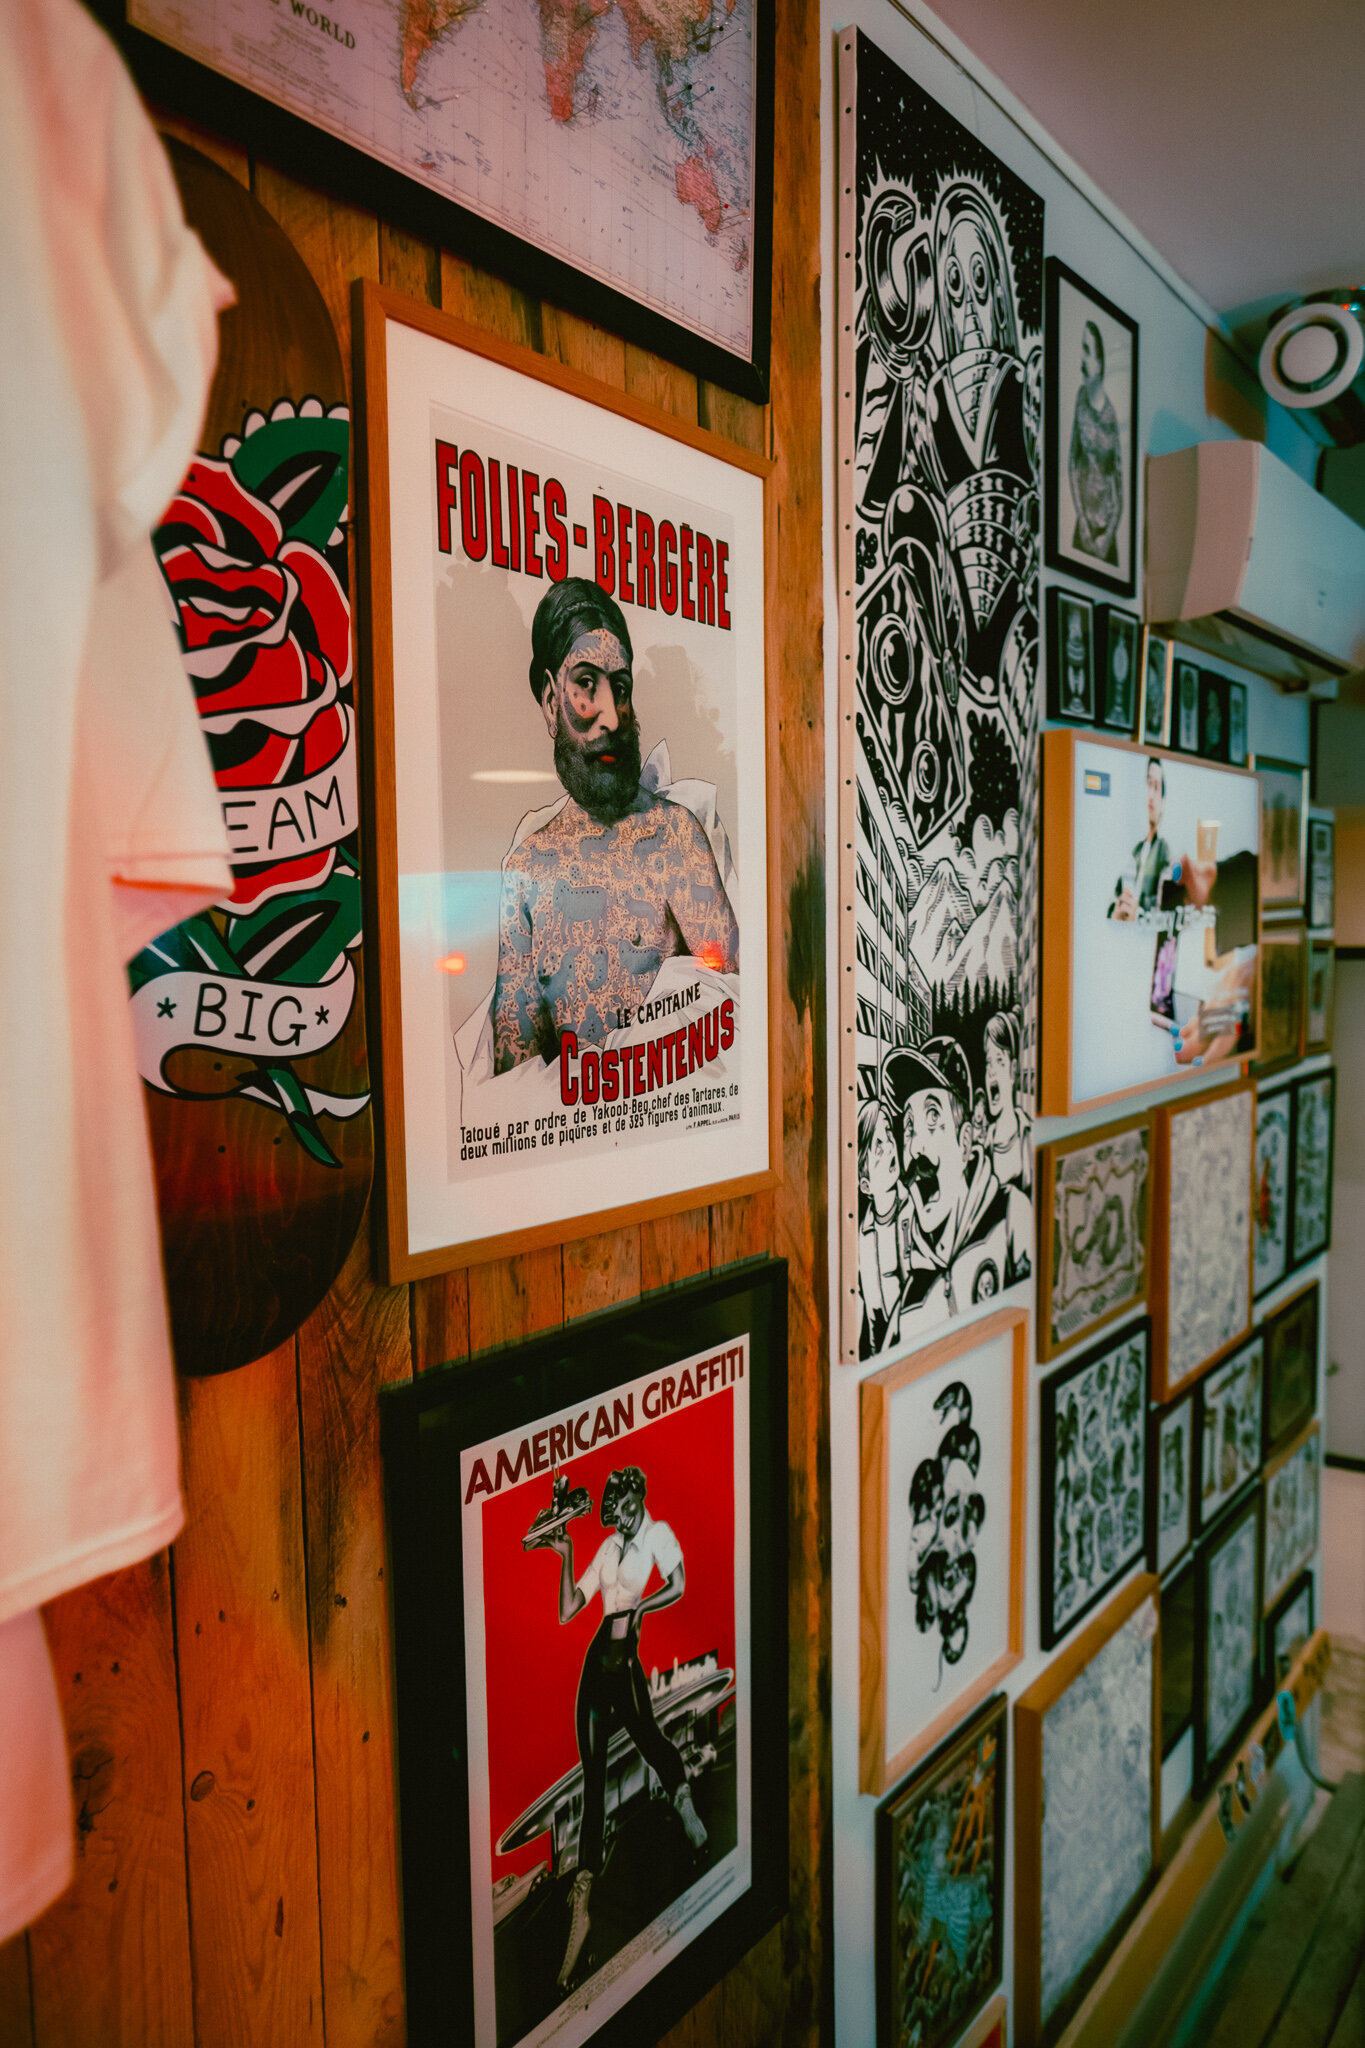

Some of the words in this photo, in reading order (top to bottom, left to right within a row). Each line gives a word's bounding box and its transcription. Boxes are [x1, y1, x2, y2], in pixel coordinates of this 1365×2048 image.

[290, 0, 356, 49] WORLD
[221, 776, 346, 853] EAM
[194, 982, 307, 1046] BIG
[616, 1008, 632, 1030] LE
[637, 981, 701, 1025] CAPITAINE
[560, 998, 734, 1105] COSTENTENUS
[460, 1122, 500, 1144] Tatoué
[508, 1120, 530, 1139] par
[535, 1111, 567, 1131] ordre
[573, 1108, 587, 1124] de
[674, 1092, 690, 1106] des
[729, 1083, 739, 1096] de
[460, 1145, 488, 1161] deux
[492, 1135, 537, 1155] millions
[541, 1131, 554, 1146] de
[602, 1122, 612, 1134] et
[615, 1117, 626, 1132] de
[629, 1112, 644, 1129] 325
[648, 1110, 679, 1127] figures
[464, 1392, 635, 1505] AMERICAN
[641, 1345, 744, 1420] GRAFFITI
